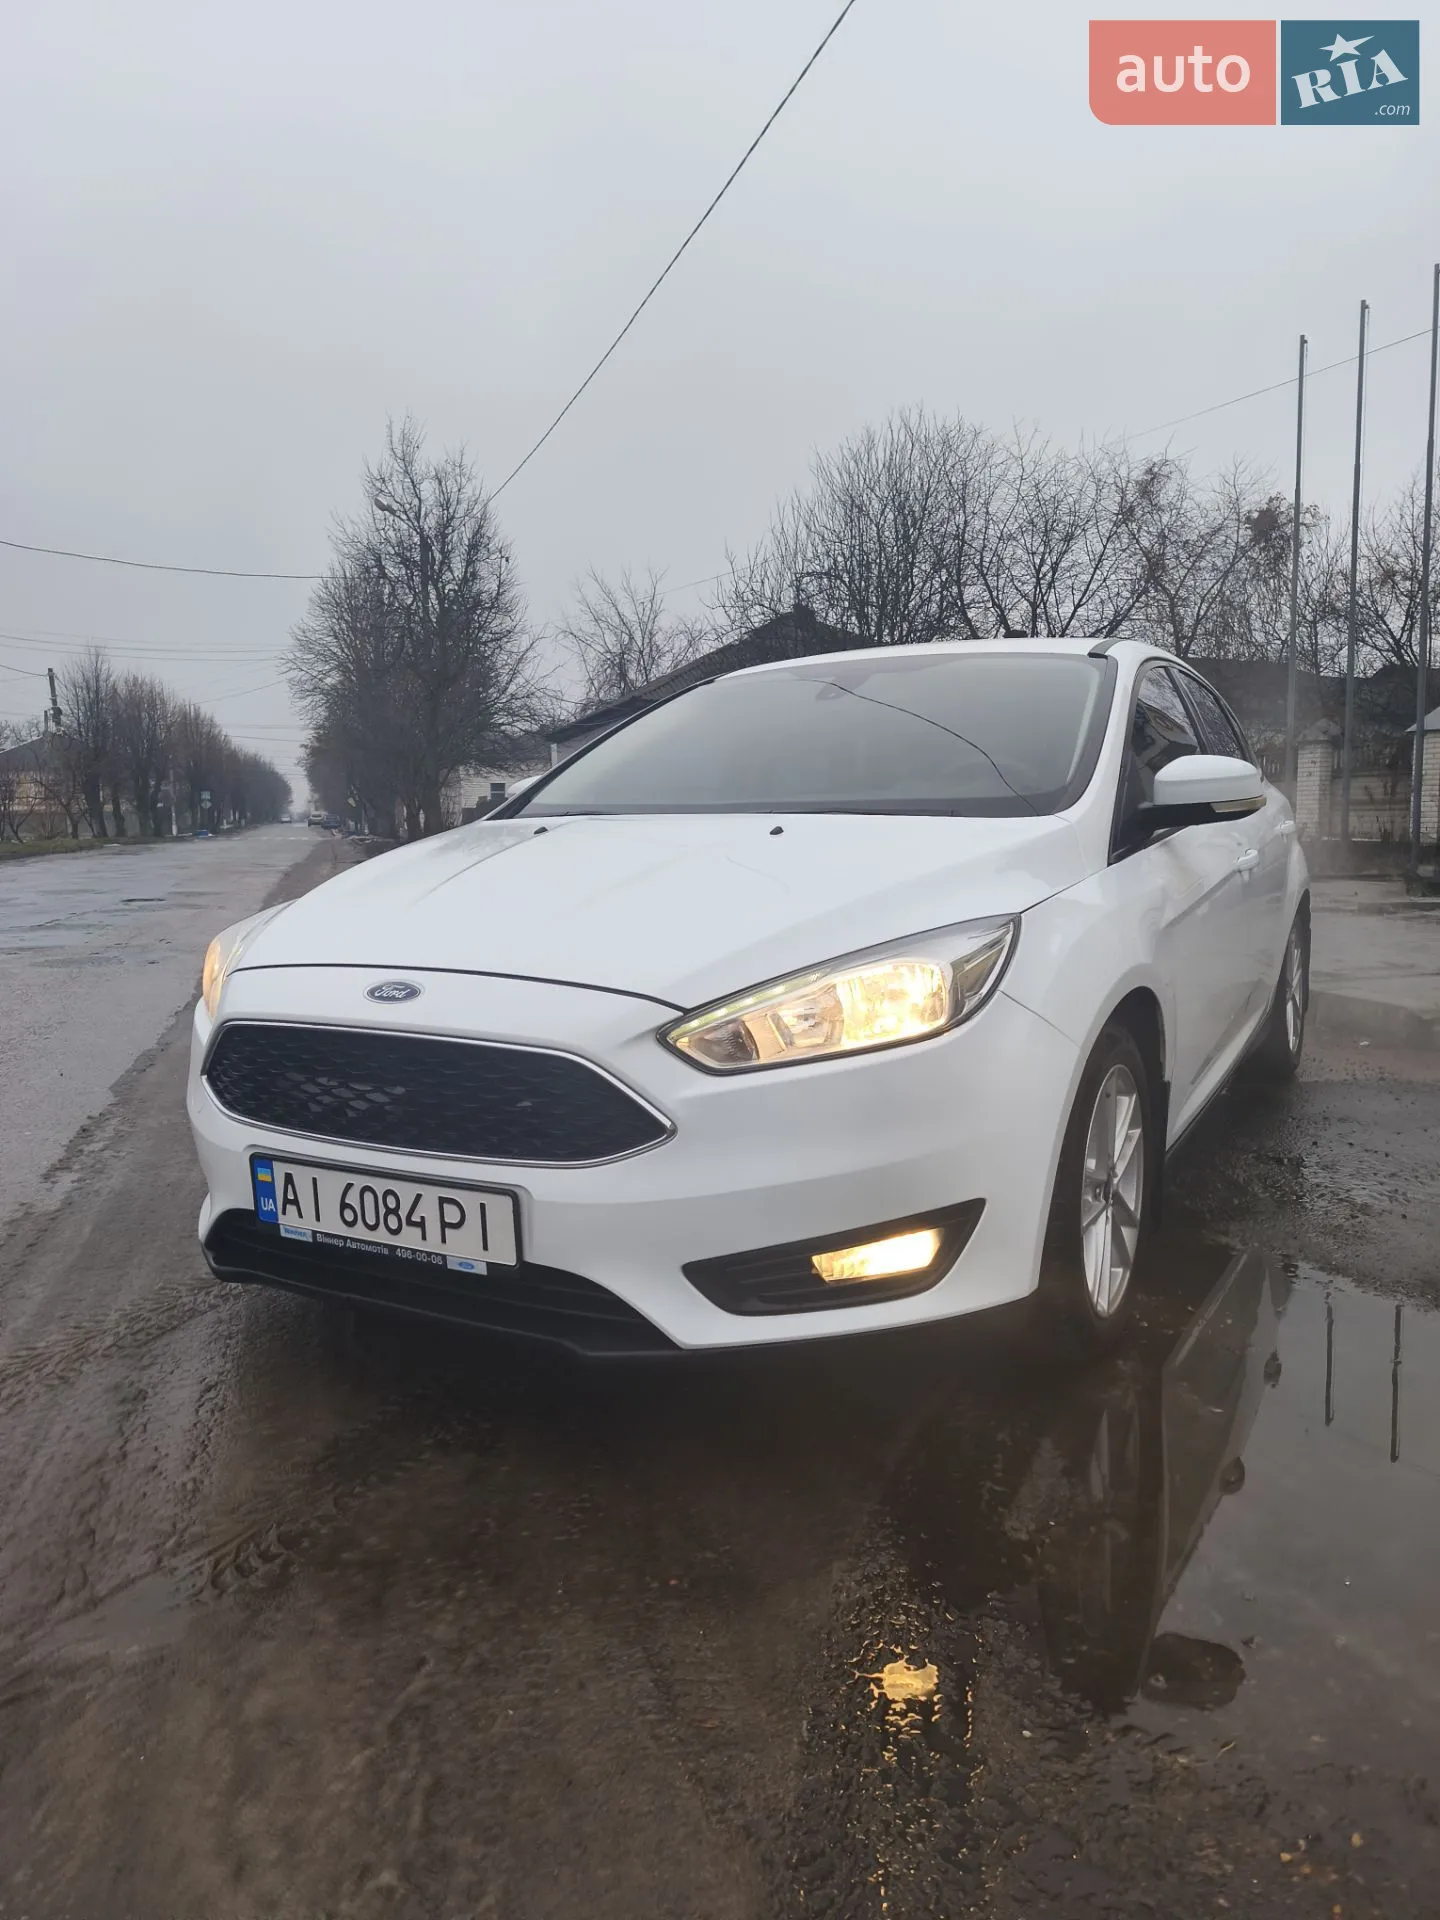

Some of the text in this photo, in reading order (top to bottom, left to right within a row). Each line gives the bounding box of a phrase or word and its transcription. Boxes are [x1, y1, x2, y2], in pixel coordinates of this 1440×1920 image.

[374, 984, 411, 998] Ford
[260, 1196, 276, 1212] UA
[281, 1172, 489, 1251] AI 6084 PI
